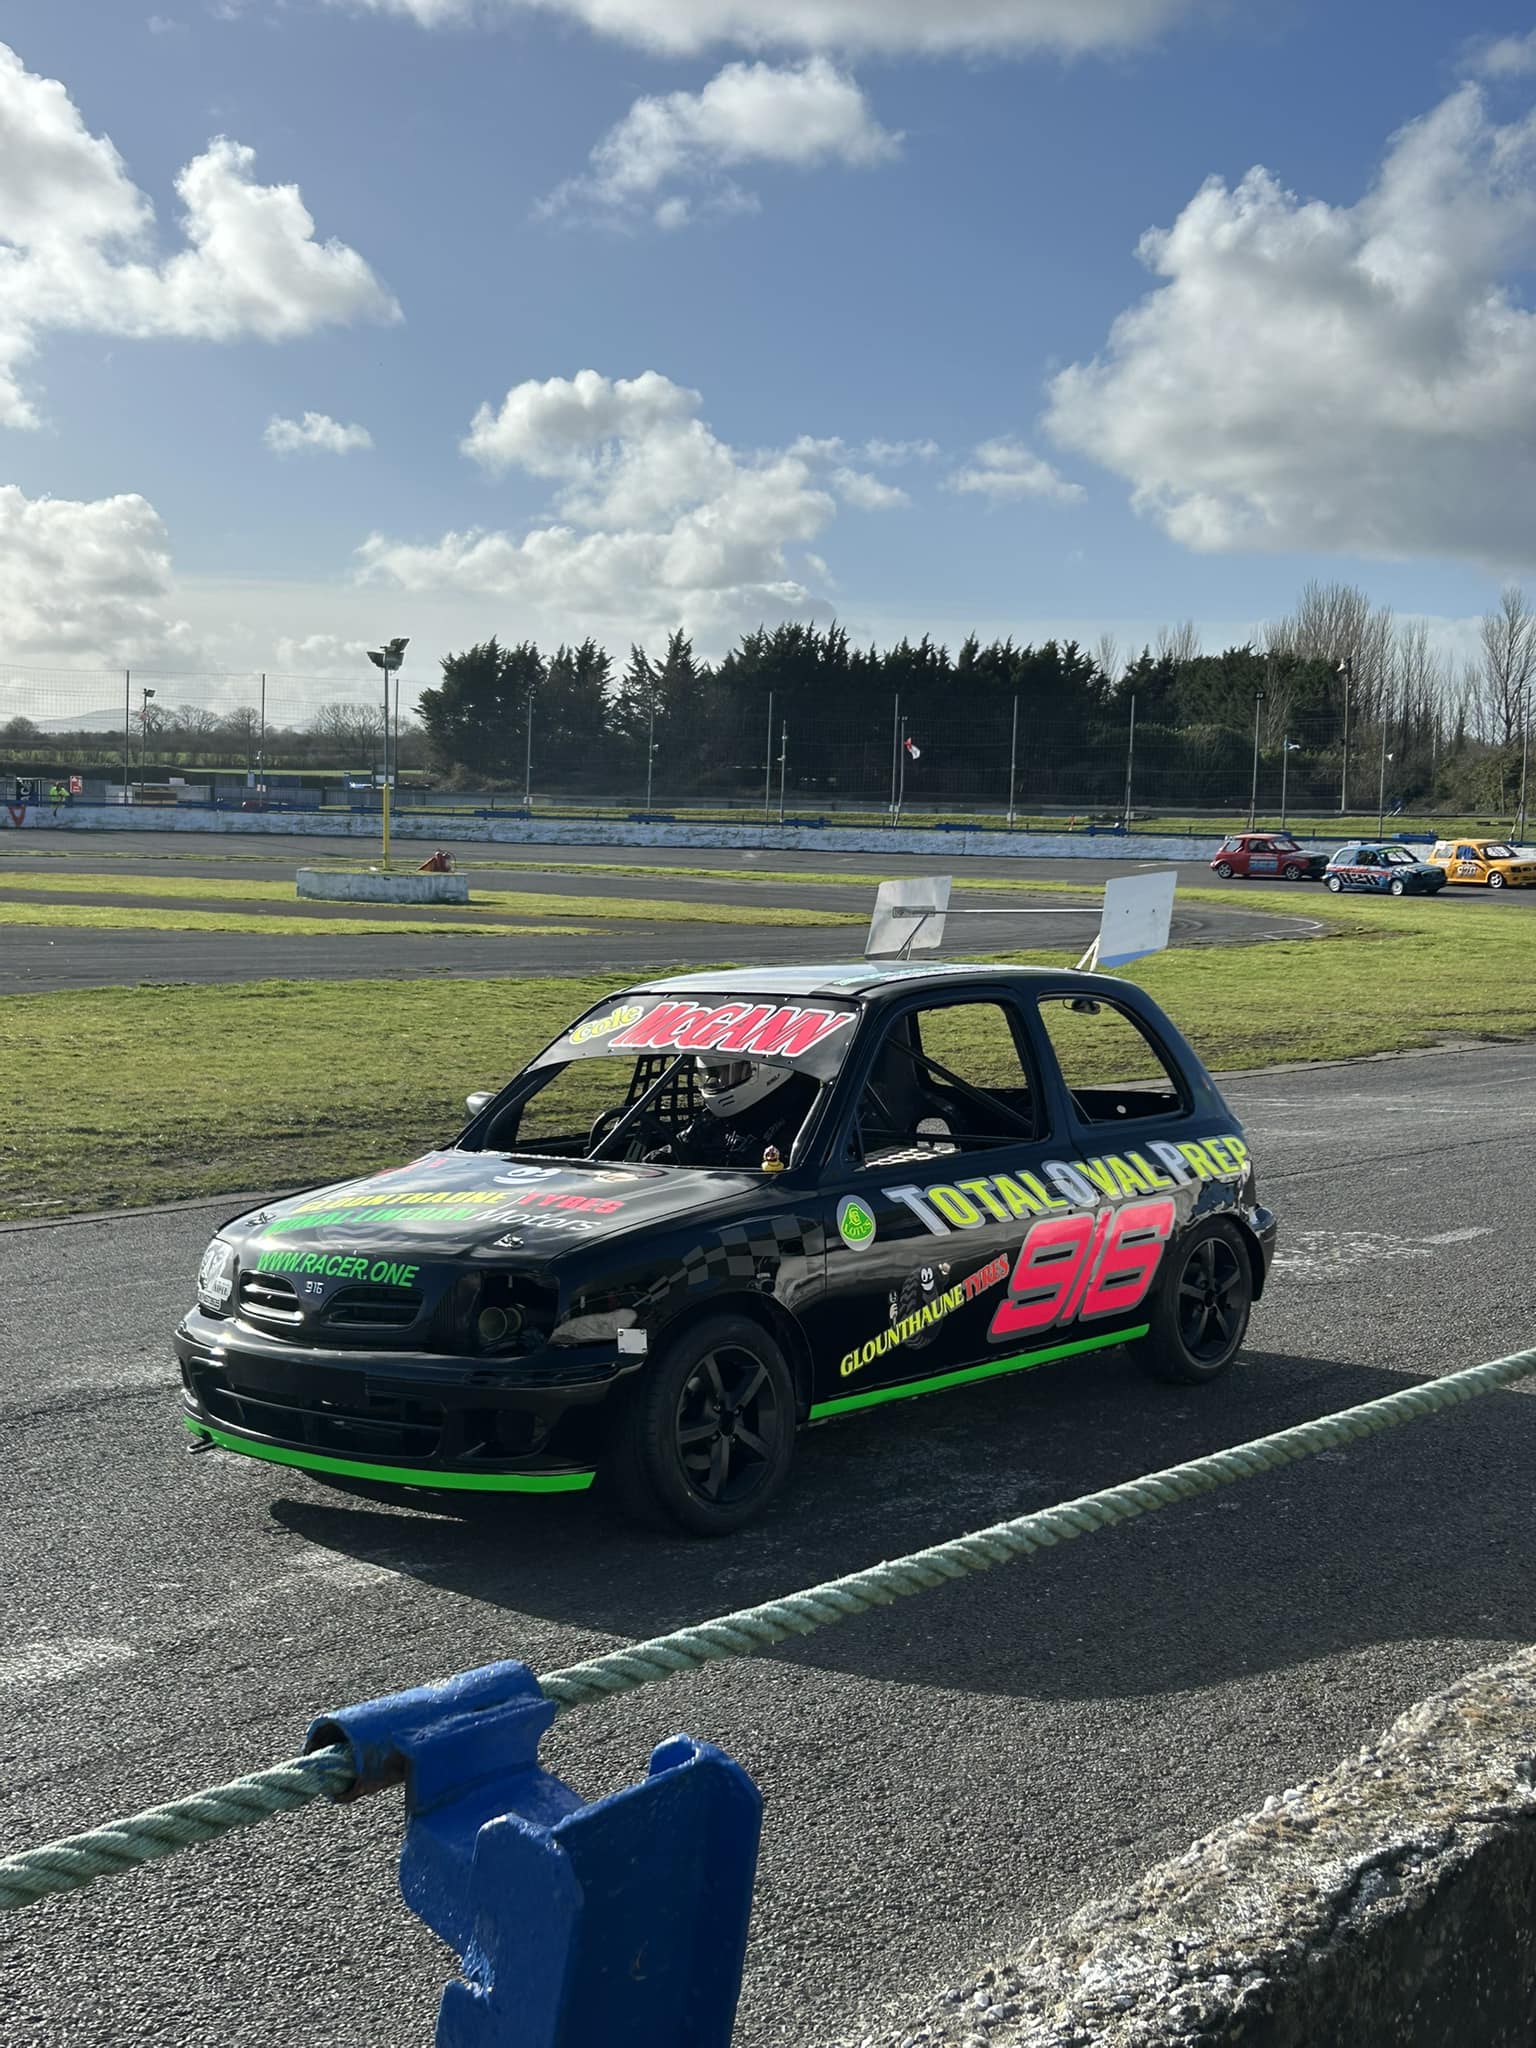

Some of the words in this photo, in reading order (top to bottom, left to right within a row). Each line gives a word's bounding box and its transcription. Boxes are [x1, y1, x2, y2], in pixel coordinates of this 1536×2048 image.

[569, 1005, 644, 1044] Cole
[464, 1208, 602, 1232] Motors
[256, 1251, 420, 1288] WWW.RACER.ONE
[304, 1280, 325, 1295] 916
[987, 1196, 1176, 1343] 916
[840, 1283, 966, 1377] GLOUNTHAUNE
[962, 1253, 1010, 1301] TYRES
